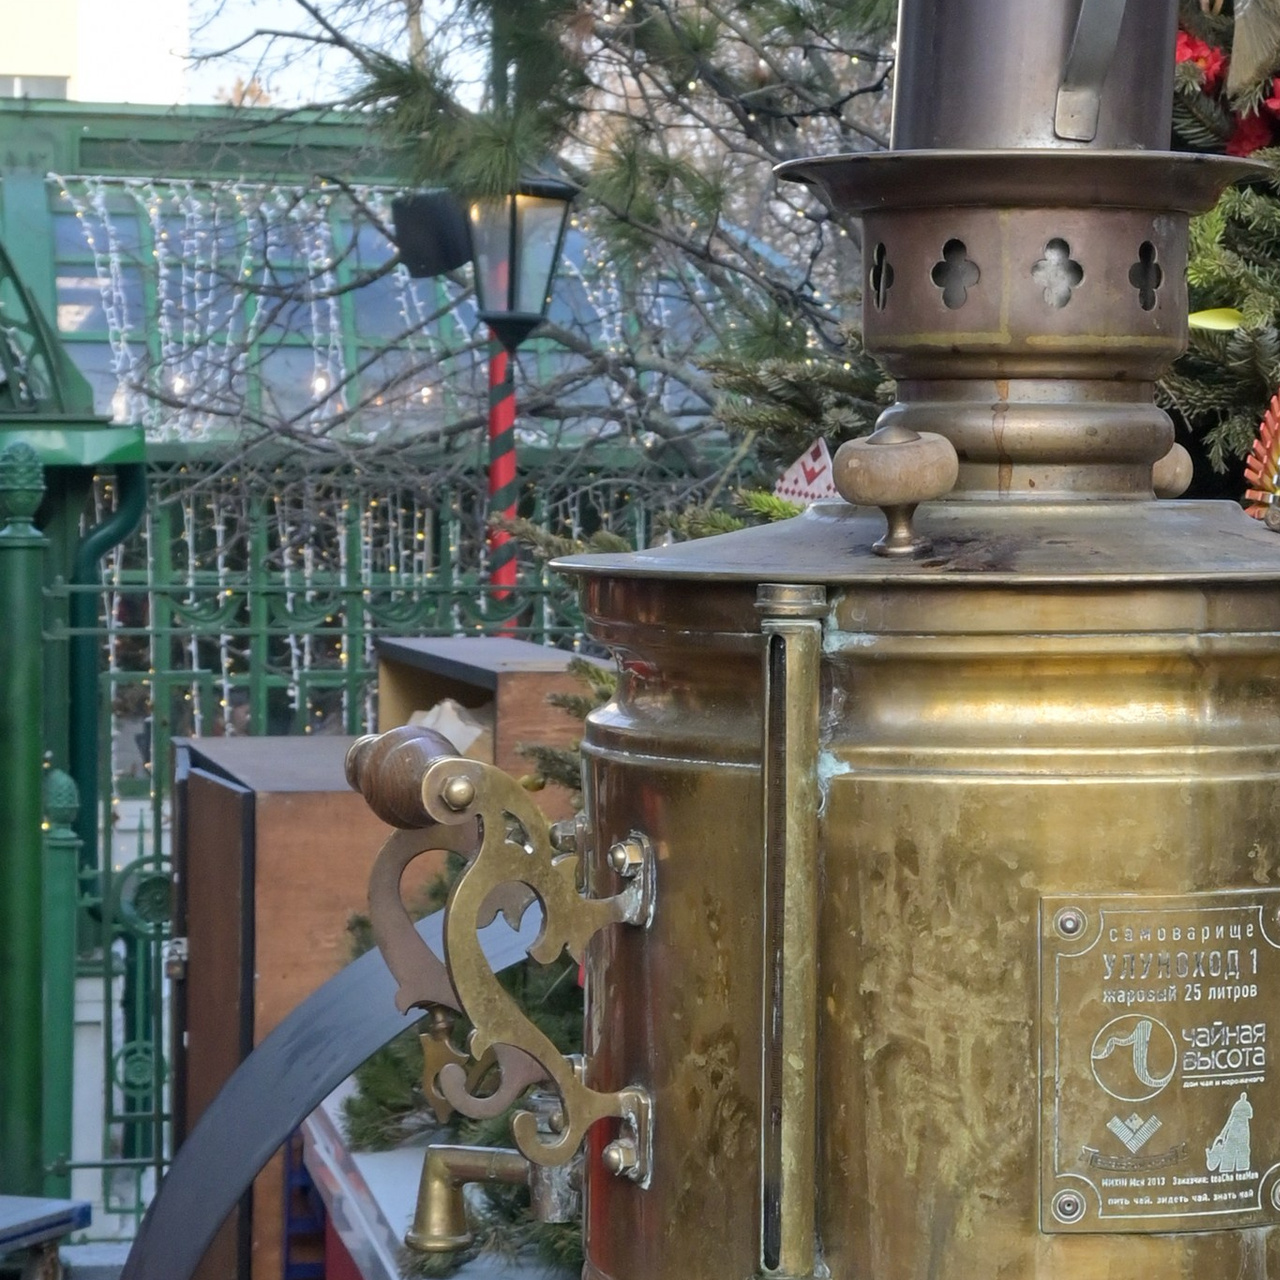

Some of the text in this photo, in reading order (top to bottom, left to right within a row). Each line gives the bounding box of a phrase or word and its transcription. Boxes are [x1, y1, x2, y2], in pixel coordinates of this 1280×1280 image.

[1109, 923, 1254, 943] самоварище
[1249, 948, 1258, 974] 1
[1102, 983, 1258, 1007] жаровый 25 литров
[1147, 1176, 1166, 1186] 2013
